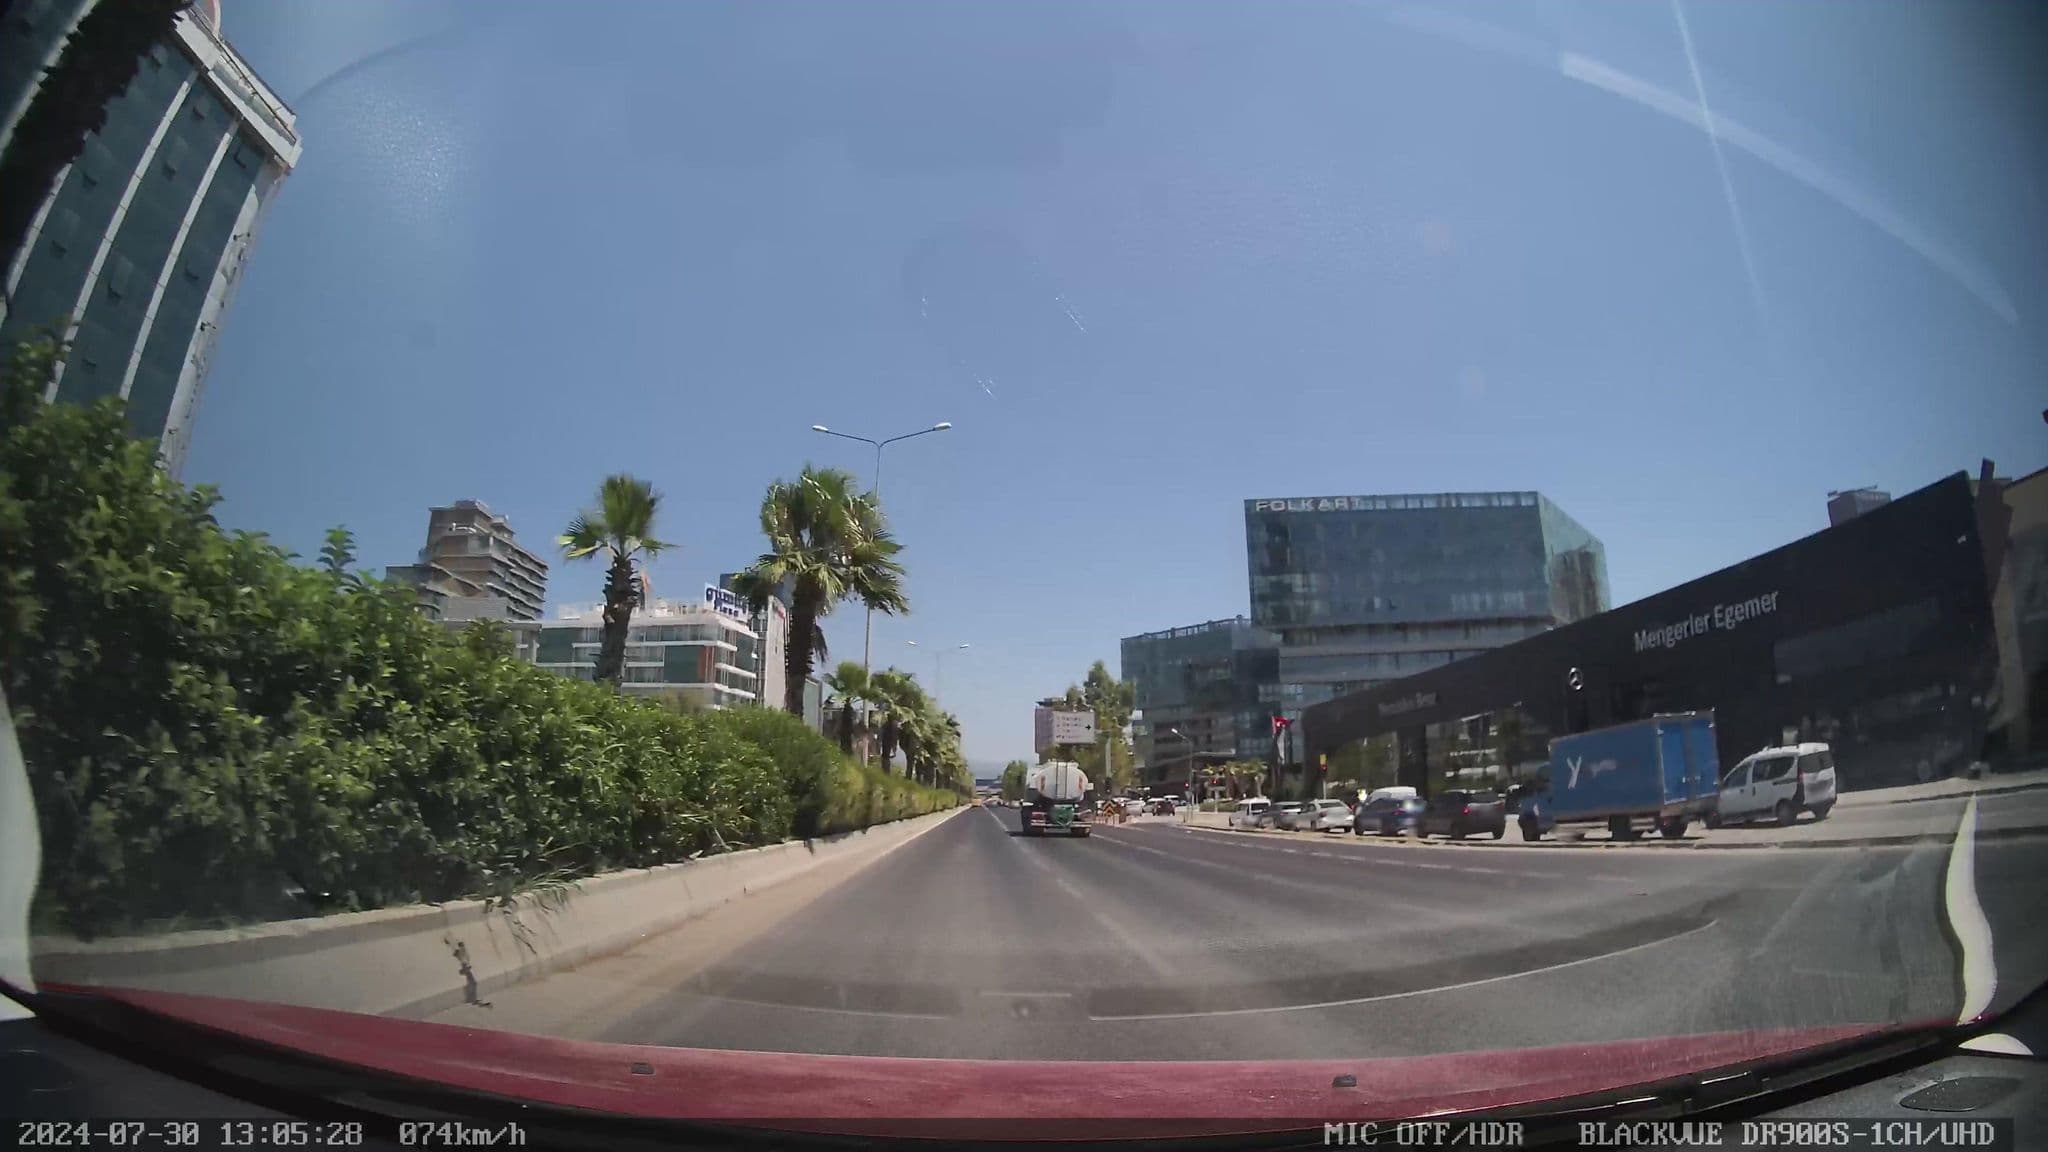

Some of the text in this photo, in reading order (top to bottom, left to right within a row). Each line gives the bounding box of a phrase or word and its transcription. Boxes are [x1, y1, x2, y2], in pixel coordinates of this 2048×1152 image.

[1257, 498, 1362, 512] FOLKART
[1634, 590, 1779, 652] Mengerler Egemer
